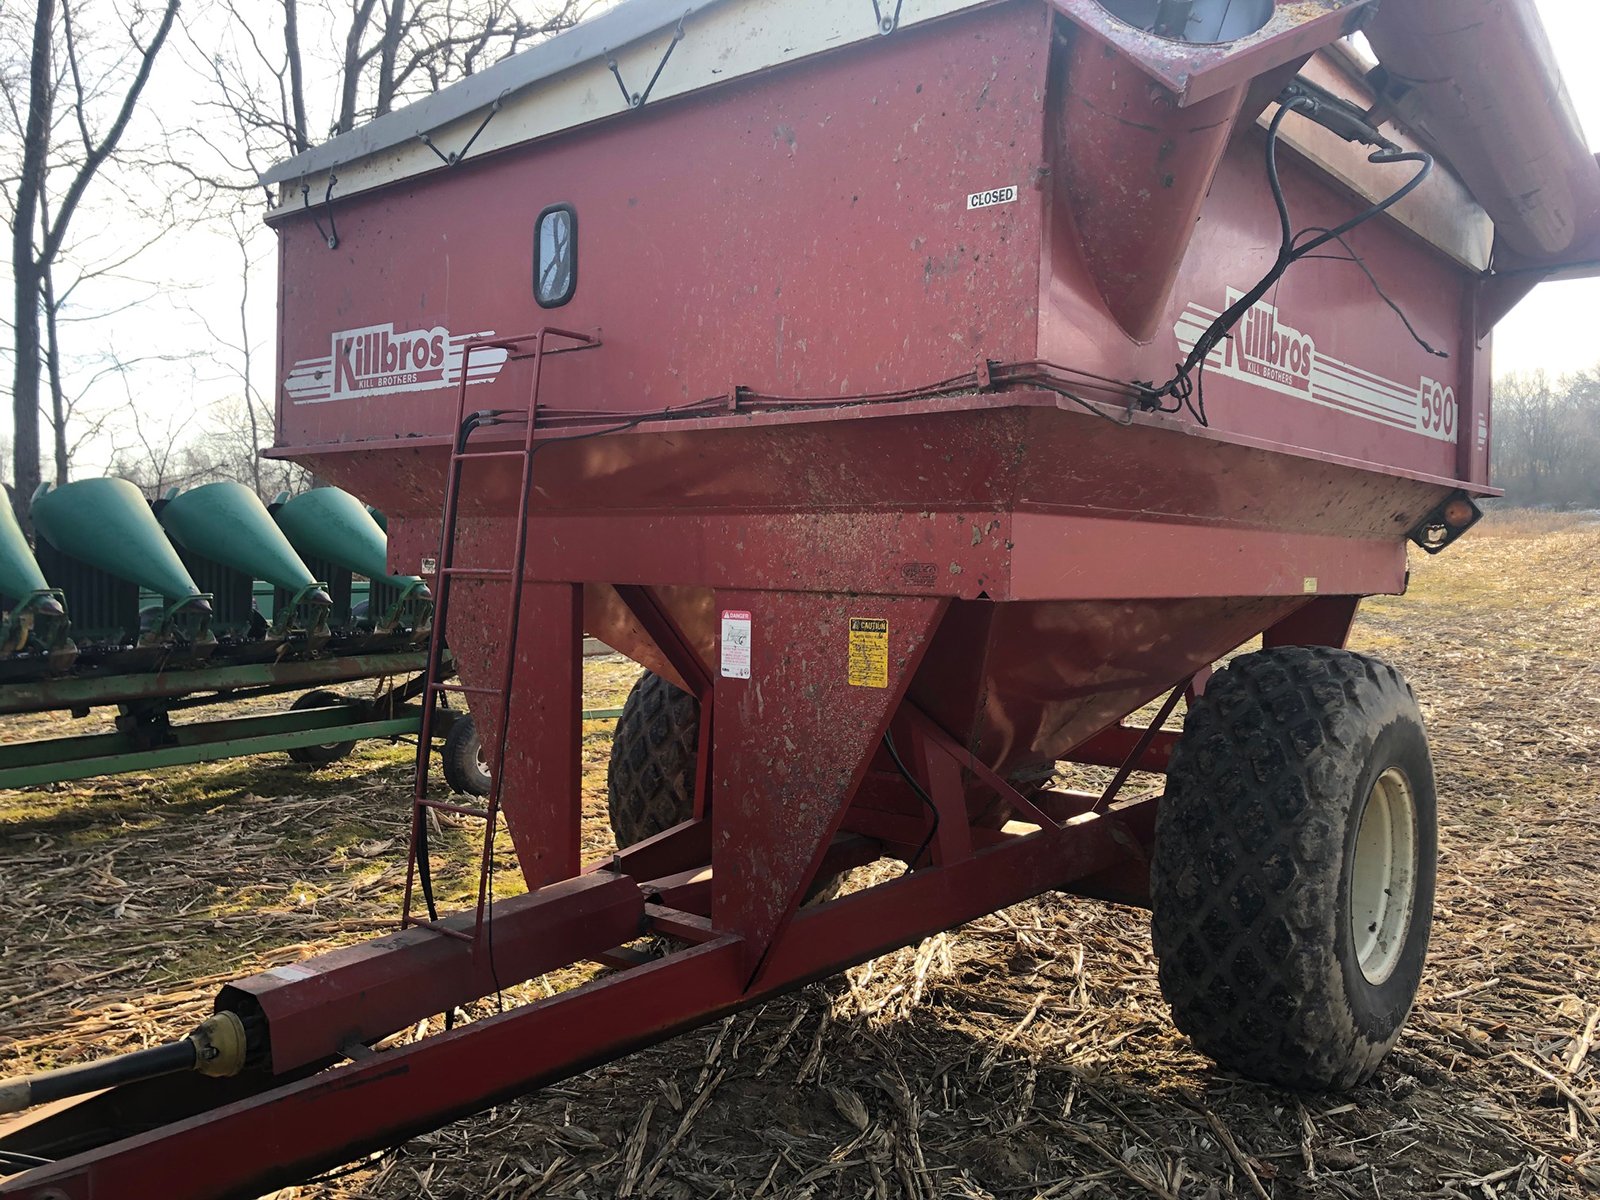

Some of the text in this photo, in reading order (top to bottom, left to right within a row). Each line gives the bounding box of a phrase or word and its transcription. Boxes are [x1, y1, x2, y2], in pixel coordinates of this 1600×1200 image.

[971, 188, 1013, 207] CLOSED
[1224, 296, 1311, 377] Killbros
[334, 330, 445, 394] Killbros
[358, 373, 418, 389] KILL BROTHERS
[1247, 363, 1293, 385] KILL BROTHERS
[1421, 383, 1454, 436] 590
[860, 621, 886, 630] CAUTION
